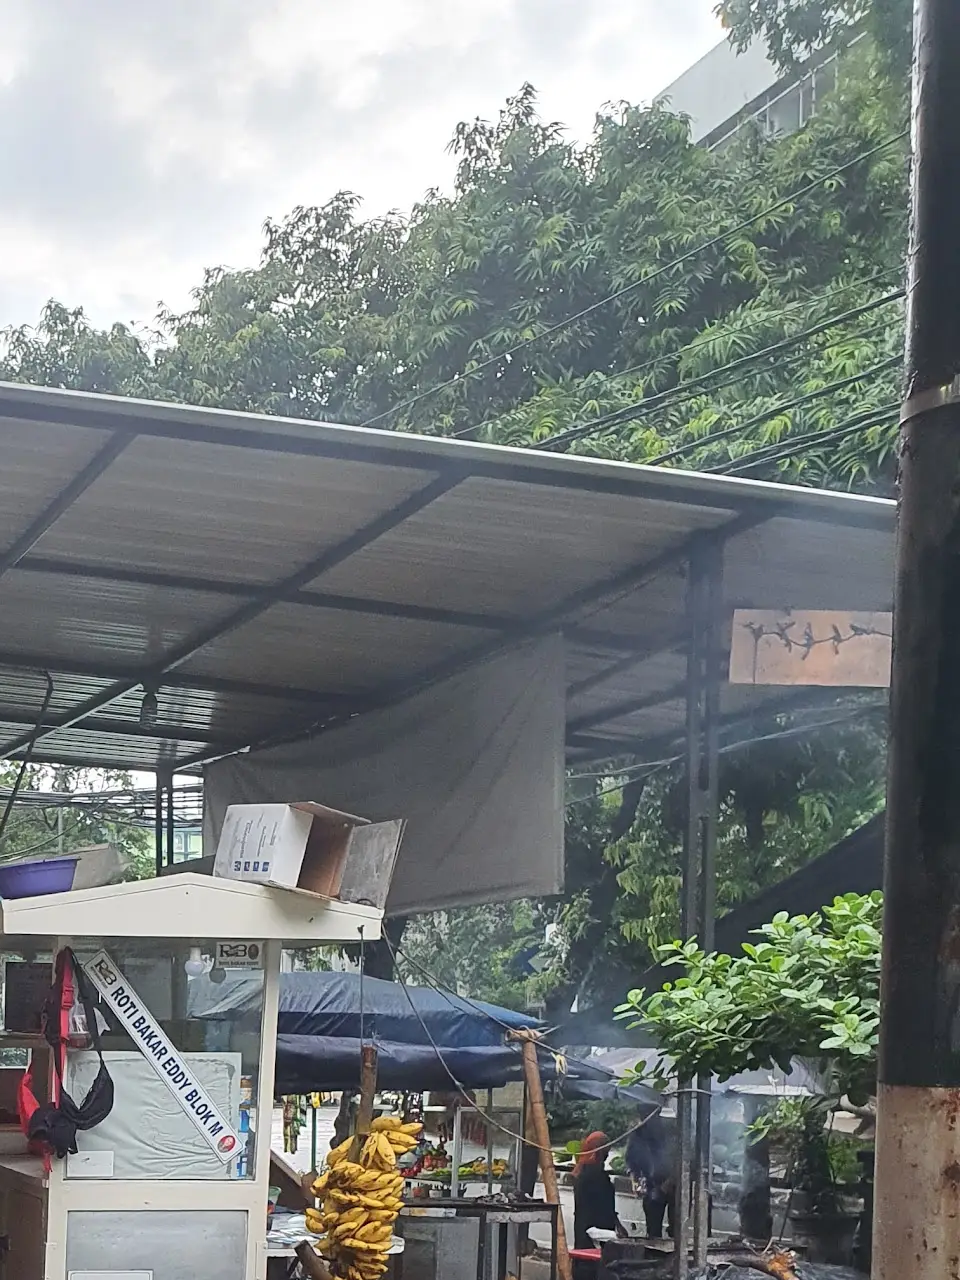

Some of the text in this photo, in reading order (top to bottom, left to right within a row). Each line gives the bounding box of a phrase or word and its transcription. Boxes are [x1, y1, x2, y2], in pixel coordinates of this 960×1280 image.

[111, 986, 224, 1137] ROTI BAKAR EDDY BLOK M
